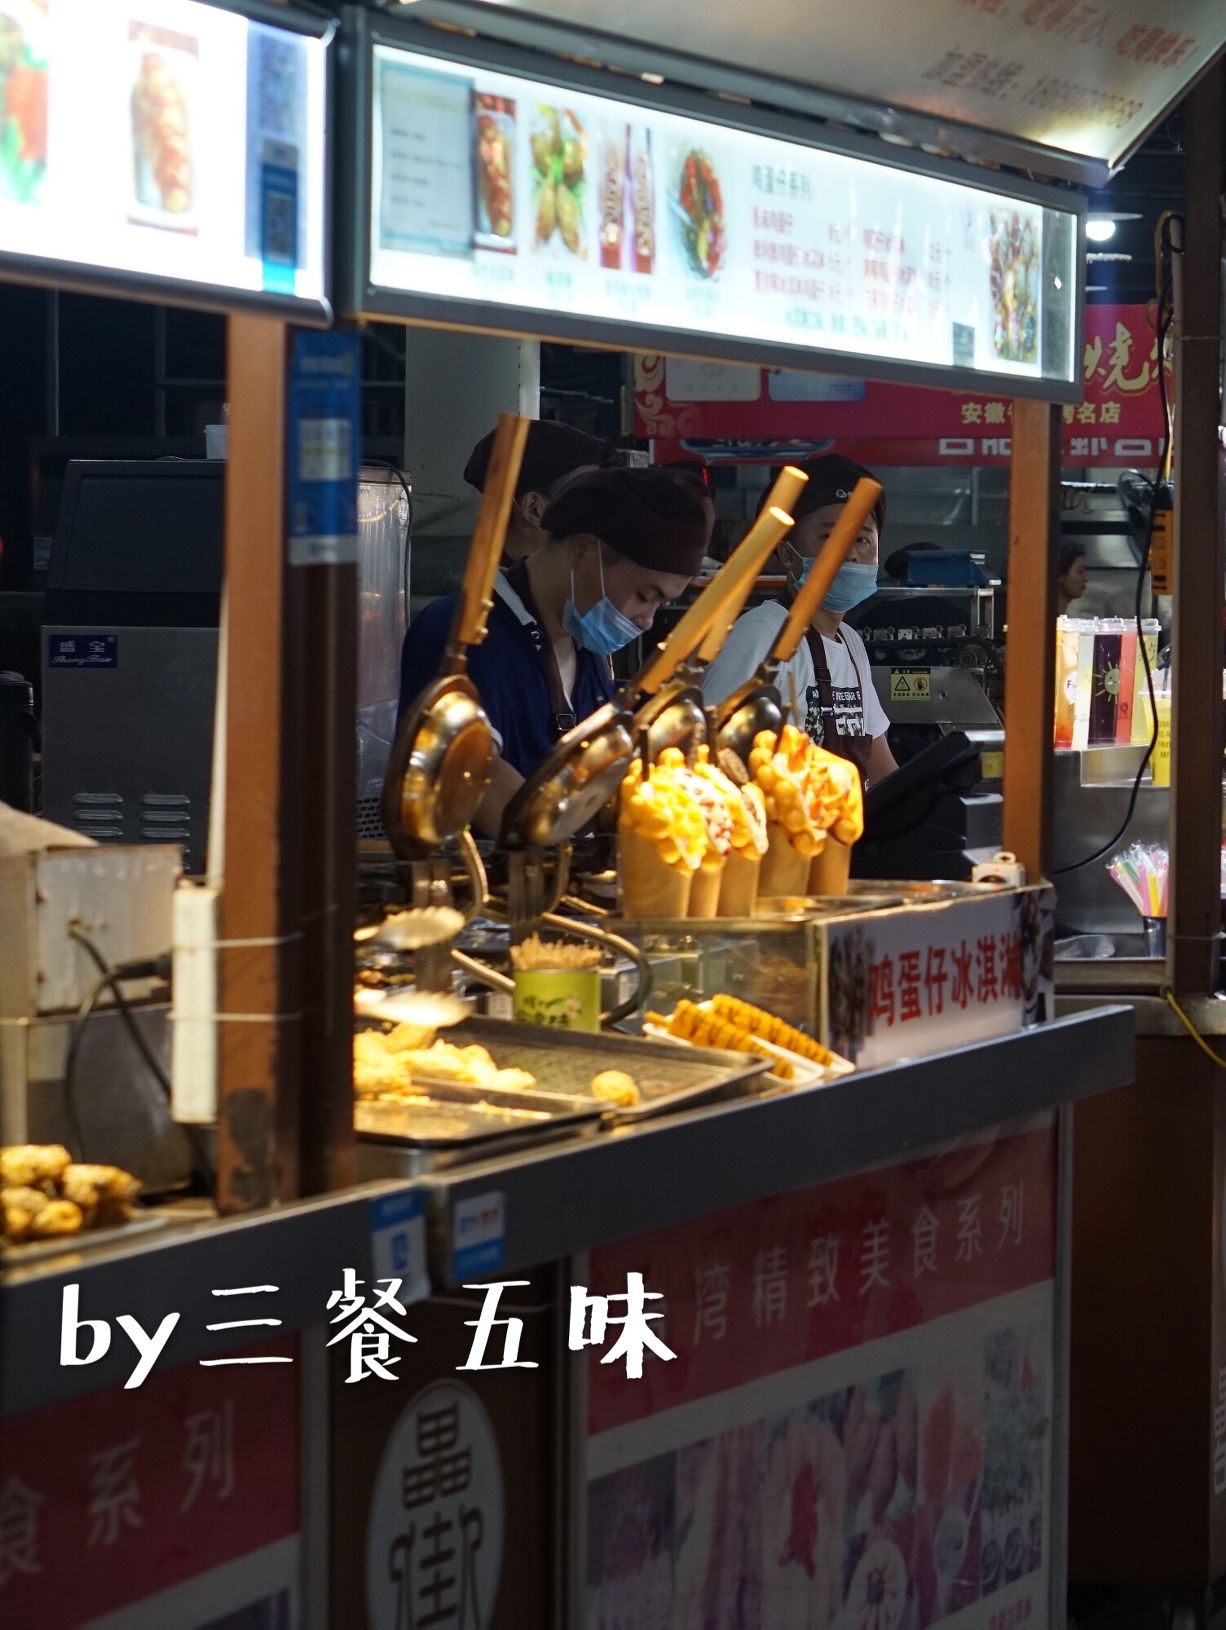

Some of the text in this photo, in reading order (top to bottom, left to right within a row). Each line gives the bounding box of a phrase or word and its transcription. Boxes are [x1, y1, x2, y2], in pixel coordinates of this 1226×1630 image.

[868, 930, 1023, 1027] 鸡蛋仔冰淇淋
[625, 1183, 1025, 1352] 湾精致美食系列
